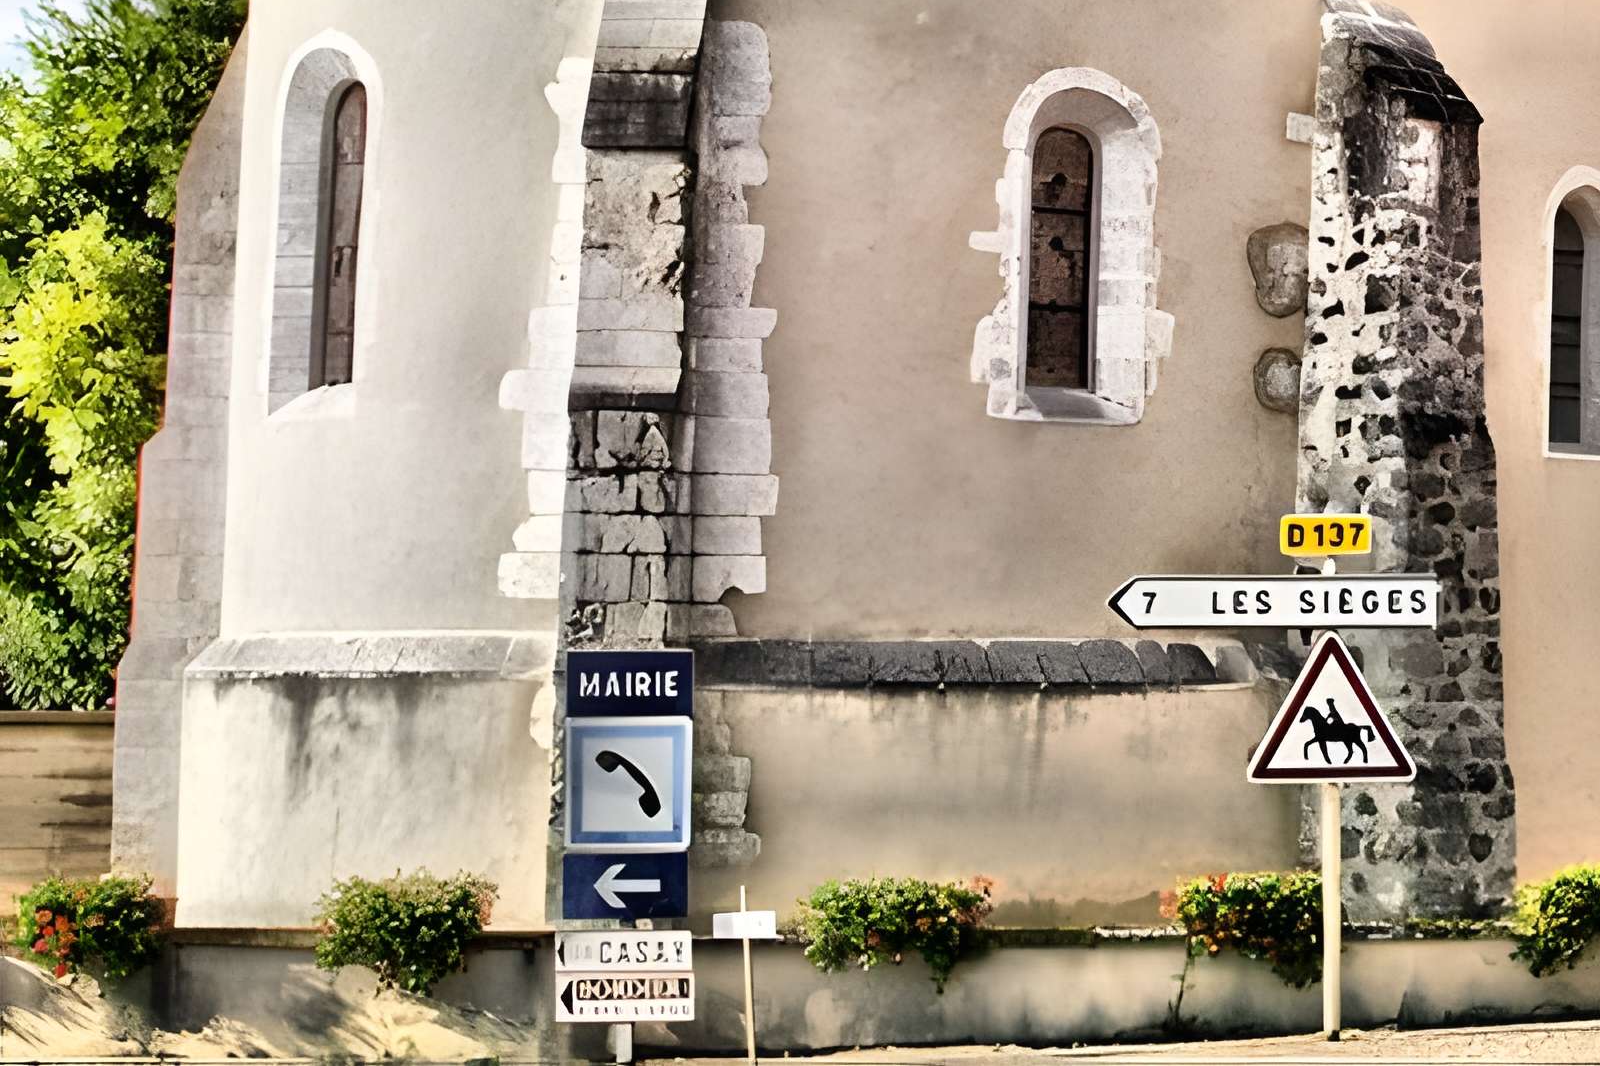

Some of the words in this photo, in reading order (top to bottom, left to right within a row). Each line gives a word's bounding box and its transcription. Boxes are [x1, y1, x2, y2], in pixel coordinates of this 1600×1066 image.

[1287, 522, 1305, 547] D
[1313, 522, 1365, 547] 137
[1142, 592, 1157, 614] 7
[1211, 590, 1272, 615] LES
[579, 670, 679, 697] MAIRIE
